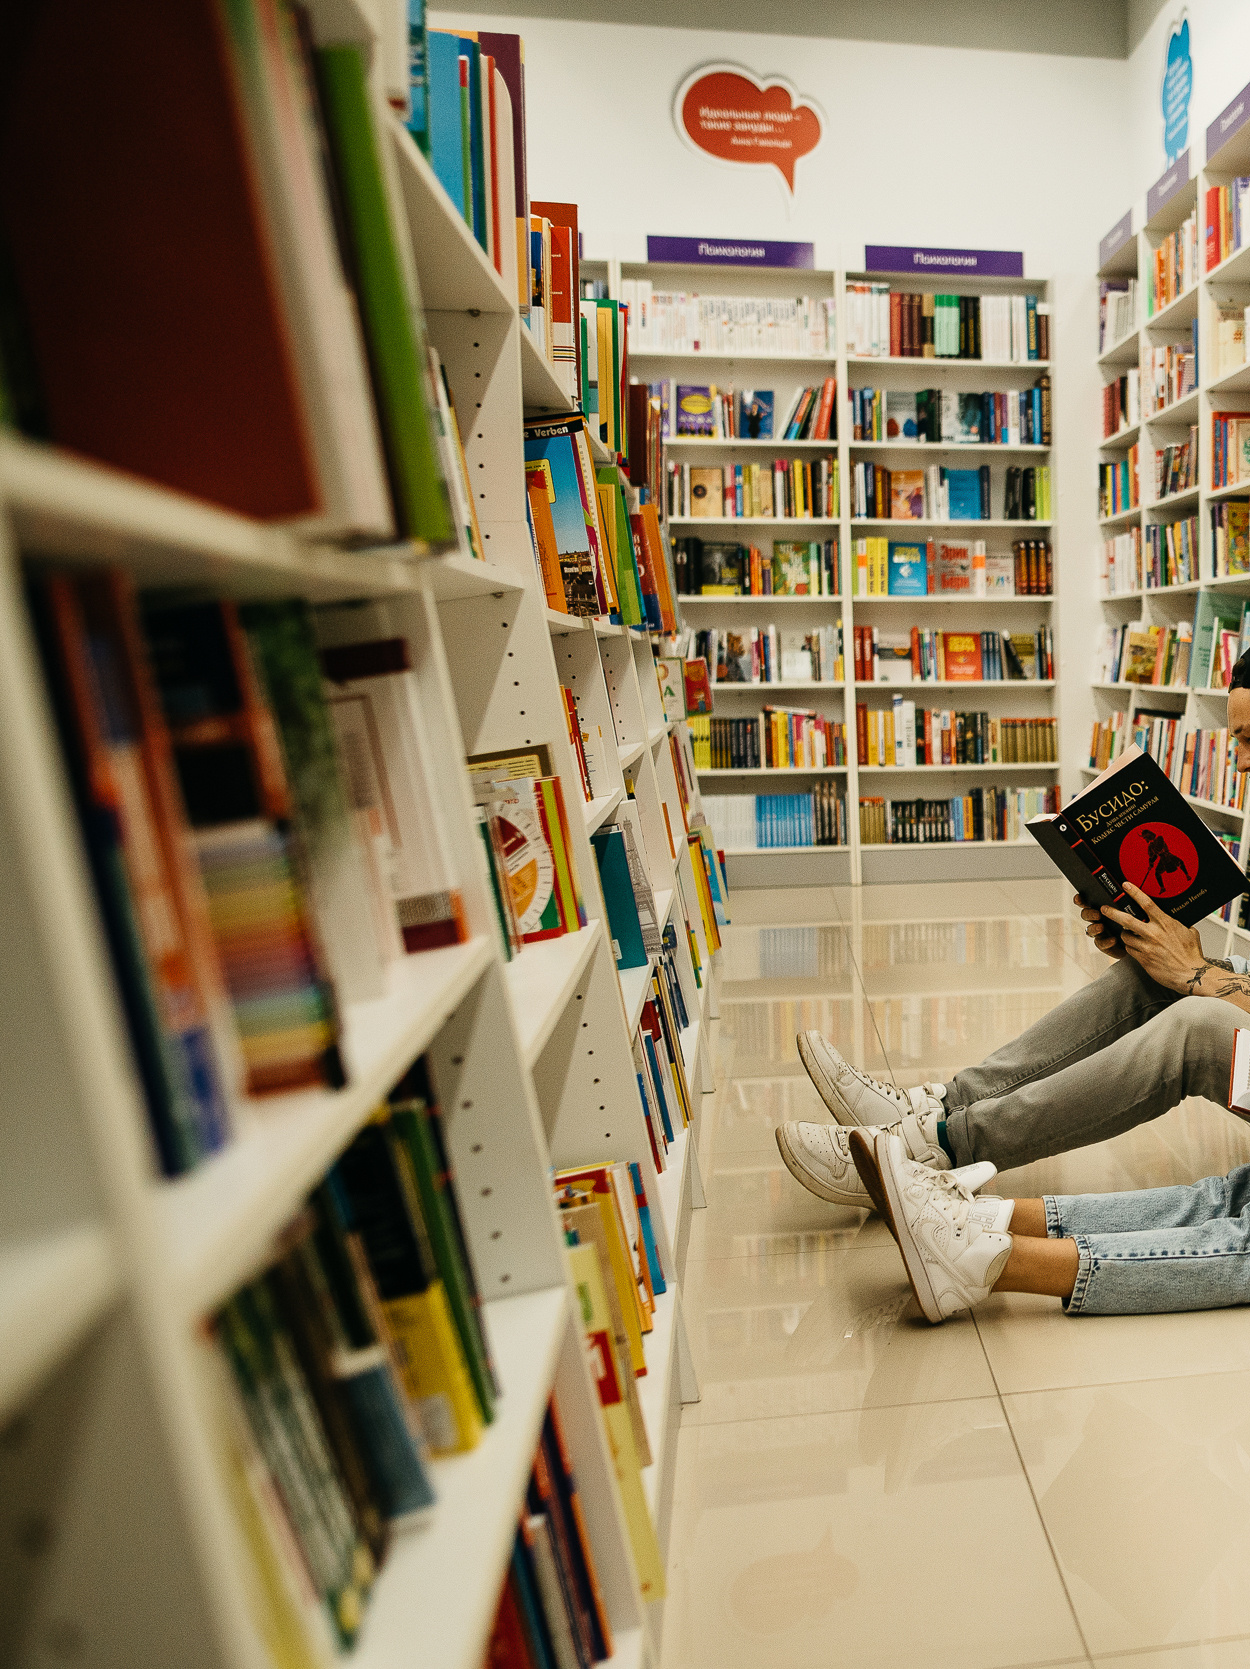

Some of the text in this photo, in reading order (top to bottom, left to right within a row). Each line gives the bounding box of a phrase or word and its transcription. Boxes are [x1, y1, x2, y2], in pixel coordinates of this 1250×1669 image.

[698, 242, 765, 258] Психология
[914, 252, 977, 267] Психология
[534, 426, 569, 438] Verben
[1076, 780, 1149, 832] БУСИДО:
